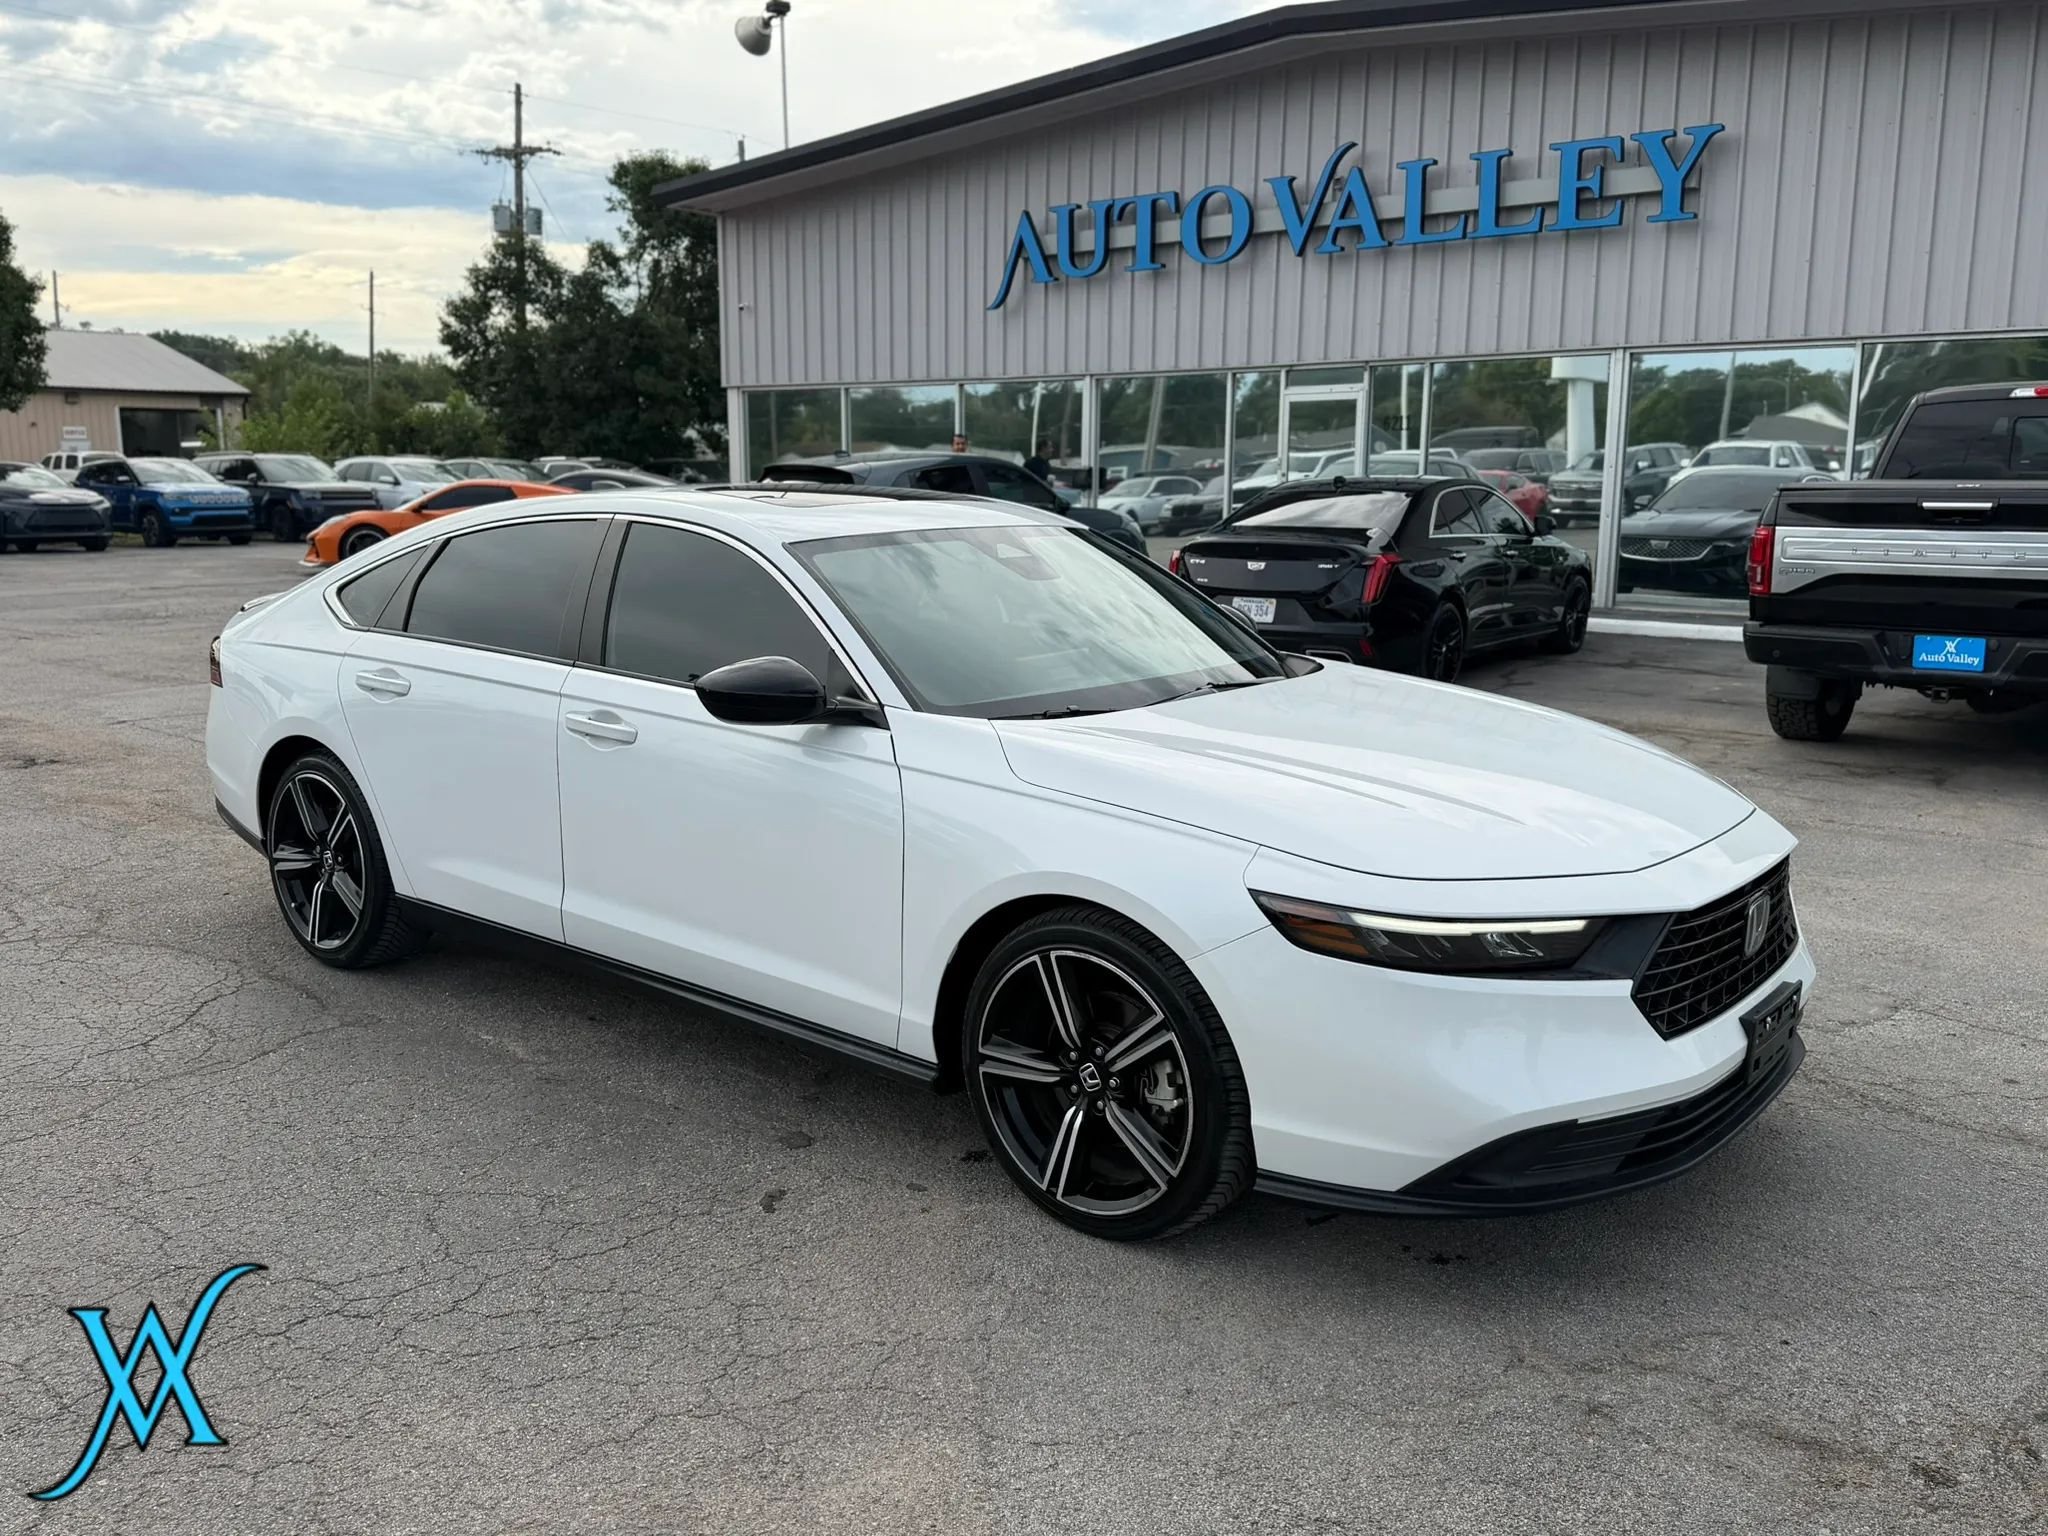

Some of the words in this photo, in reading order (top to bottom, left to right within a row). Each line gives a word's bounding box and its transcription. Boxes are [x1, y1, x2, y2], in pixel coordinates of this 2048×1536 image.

[986, 184, 1254, 311] AUTO
[1263, 123, 1725, 258] VALLEY
[1253, 604, 1270, 617] 354
[1919, 652, 1946, 662] Auto
[1947, 653, 1980, 666] Valley
